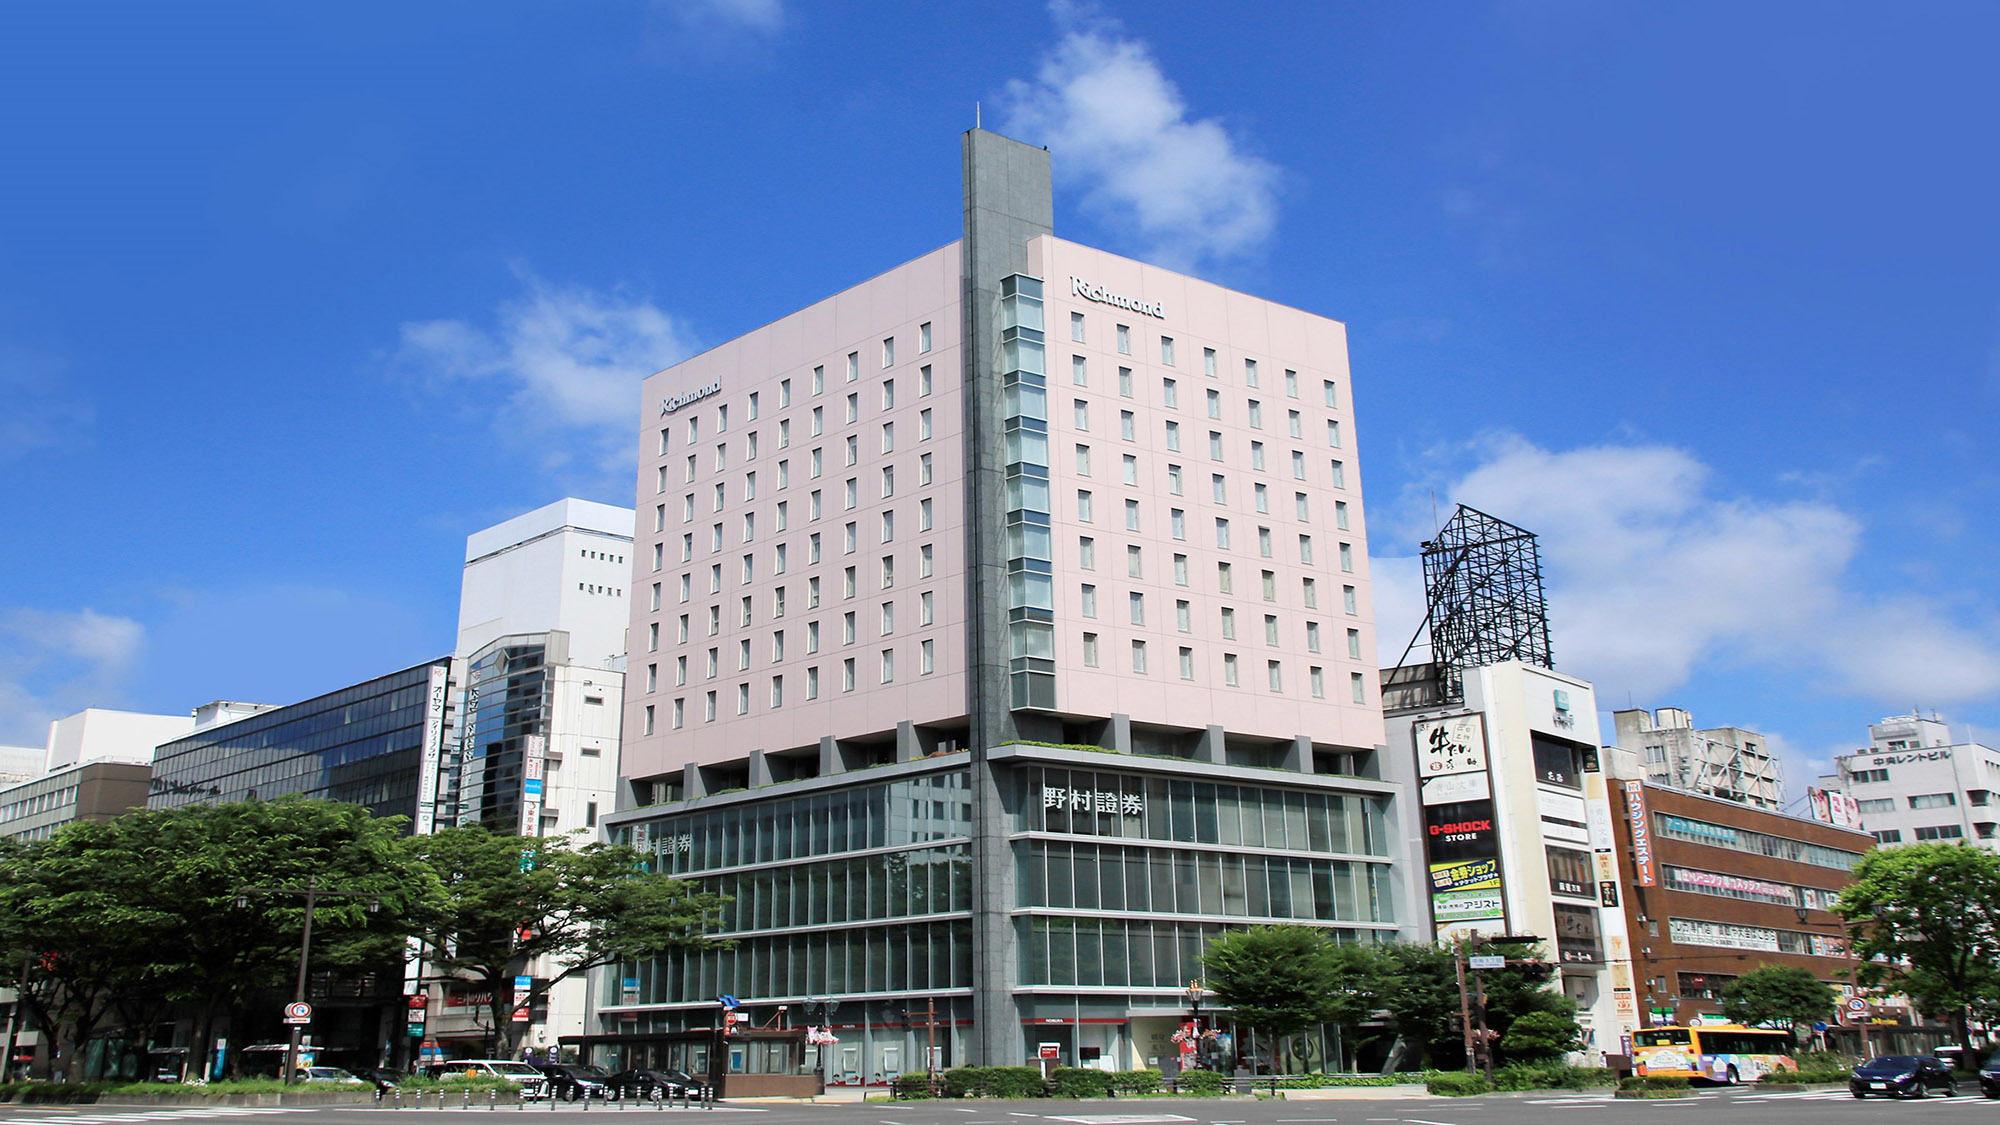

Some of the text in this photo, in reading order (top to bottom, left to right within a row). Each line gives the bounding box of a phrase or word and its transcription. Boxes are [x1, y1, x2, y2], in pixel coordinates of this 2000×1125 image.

[1069, 275, 1166, 319] Richmond
[661, 375, 722, 417] Richmond
[433, 686, 442, 712] オーヤマ
[1429, 725, 1471, 757] 牛たん
[1873, 751, 1952, 766] 中央レントビル
[1043, 786, 1143, 816] 野村證券
[1430, 820, 1491, 835] G-SHOCK
[1445, 833, 1477, 842] STORE
[1629, 793, 1654, 884] ハウジングエステート
[1450, 859, 1496, 881] 金券ショップ
